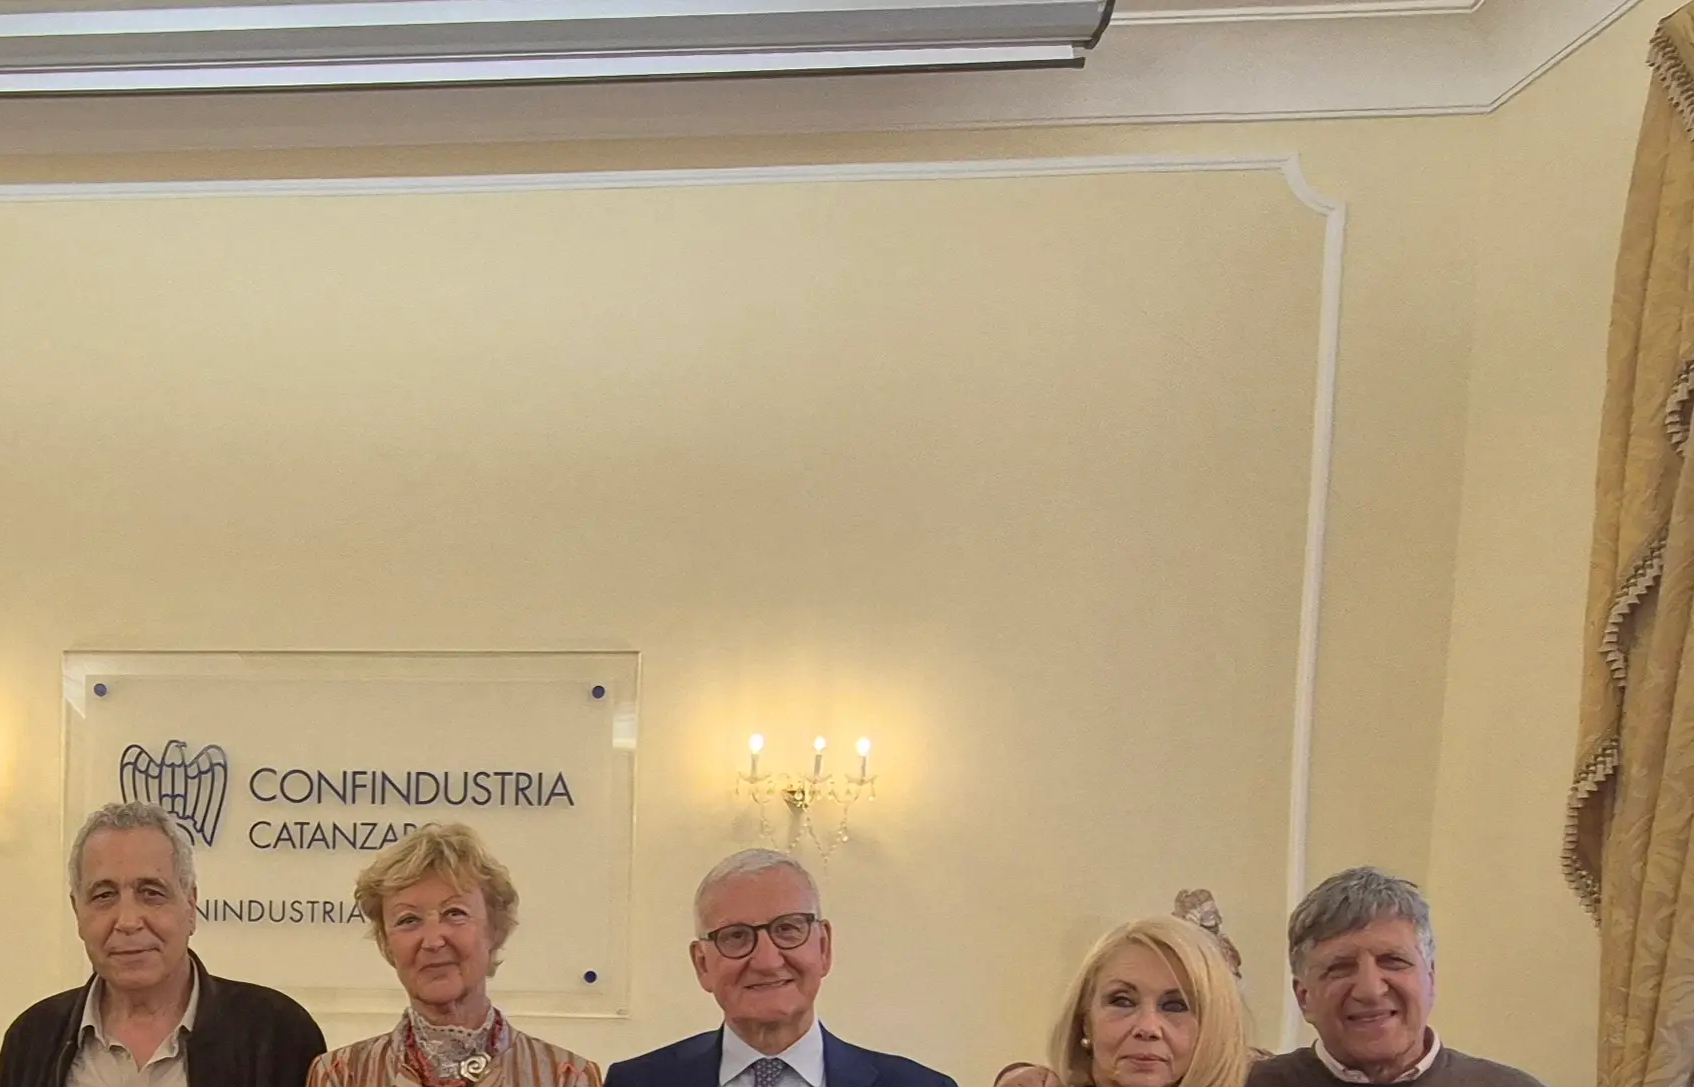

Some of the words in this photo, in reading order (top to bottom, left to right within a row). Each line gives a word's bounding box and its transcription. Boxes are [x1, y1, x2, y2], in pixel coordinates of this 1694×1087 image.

[249, 767, 575, 807] CONFINDUSTRIA
[249, 820, 441, 850] CATANZA
[195, 899, 366, 924] NINDUSTRIA
